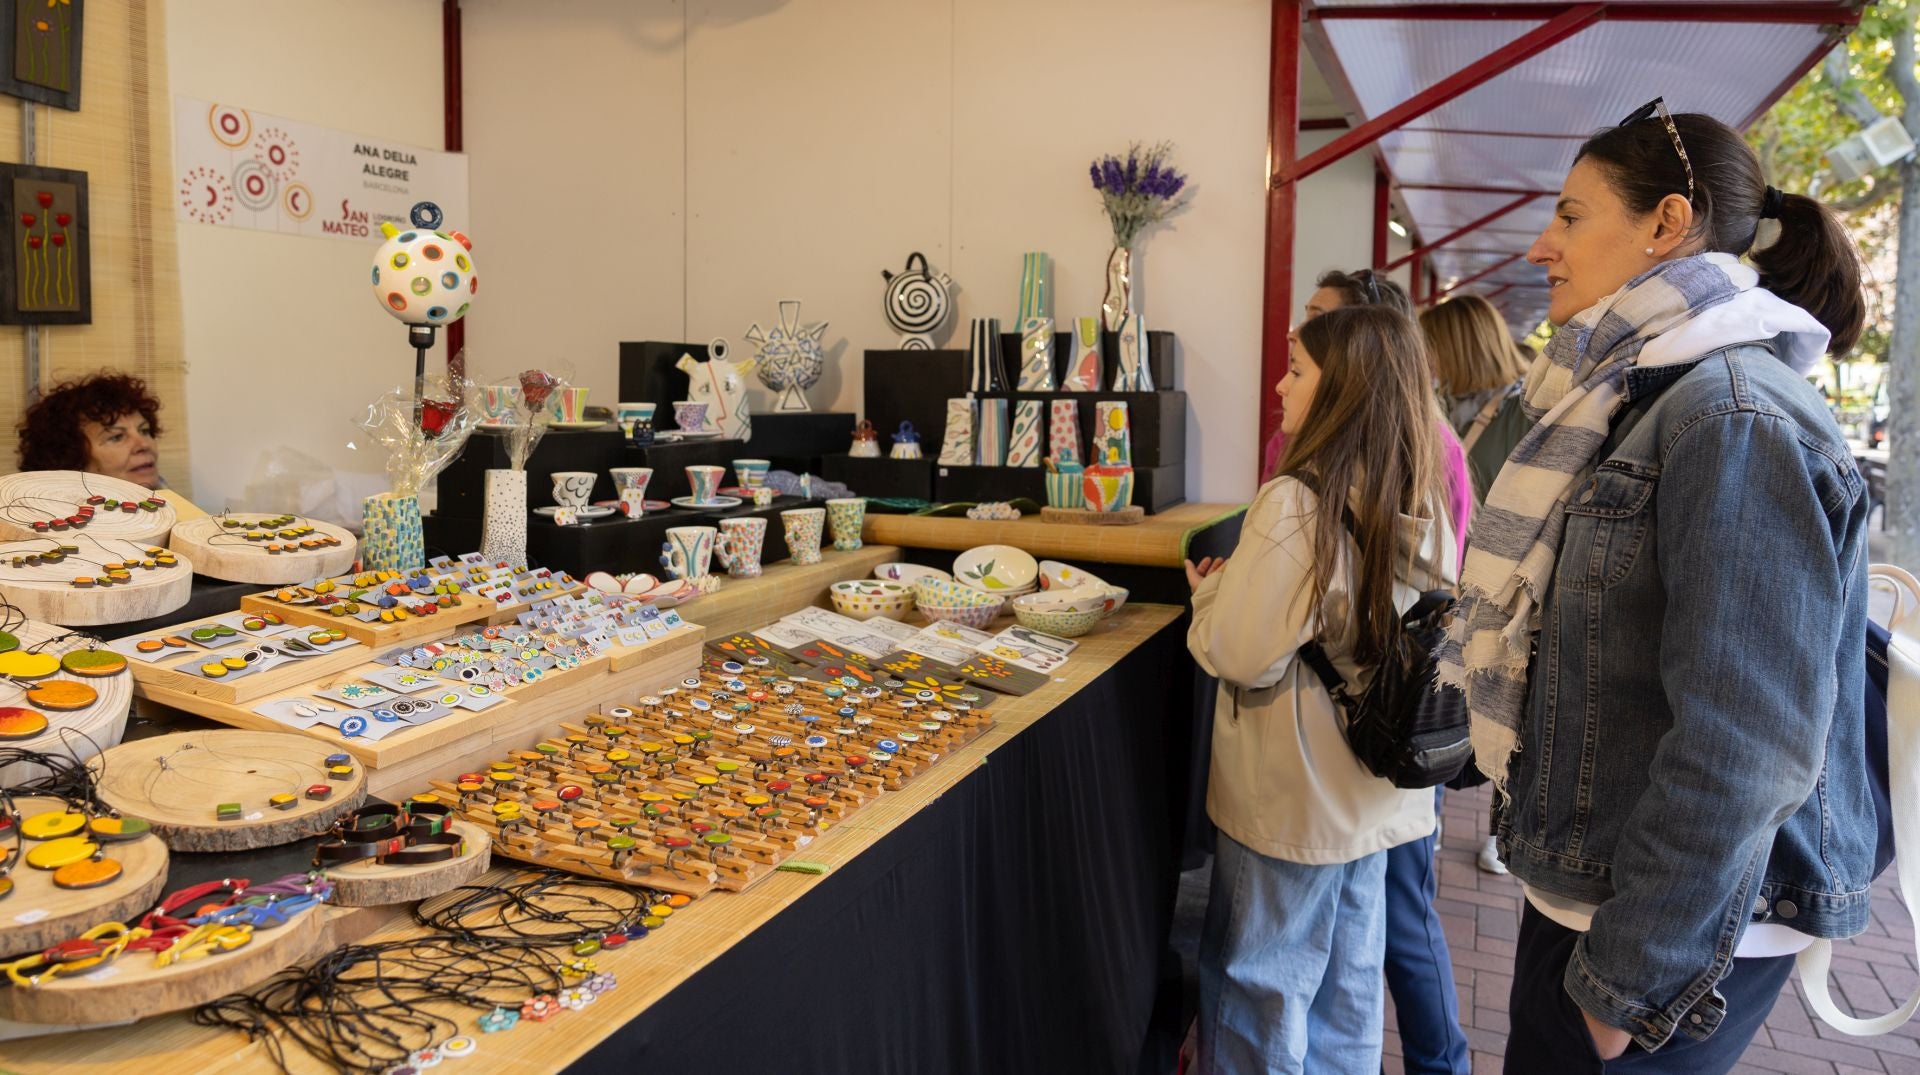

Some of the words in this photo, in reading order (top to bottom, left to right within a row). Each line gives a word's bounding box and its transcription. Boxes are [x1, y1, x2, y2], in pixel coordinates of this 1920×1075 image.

[353, 143, 380, 158] ANA
[383, 149, 418, 166] DELIA
[362, 163, 410, 182] ALEGRE
[363, 181, 409, 195] BARCELONA
[322, 220, 369, 238] MATEO
